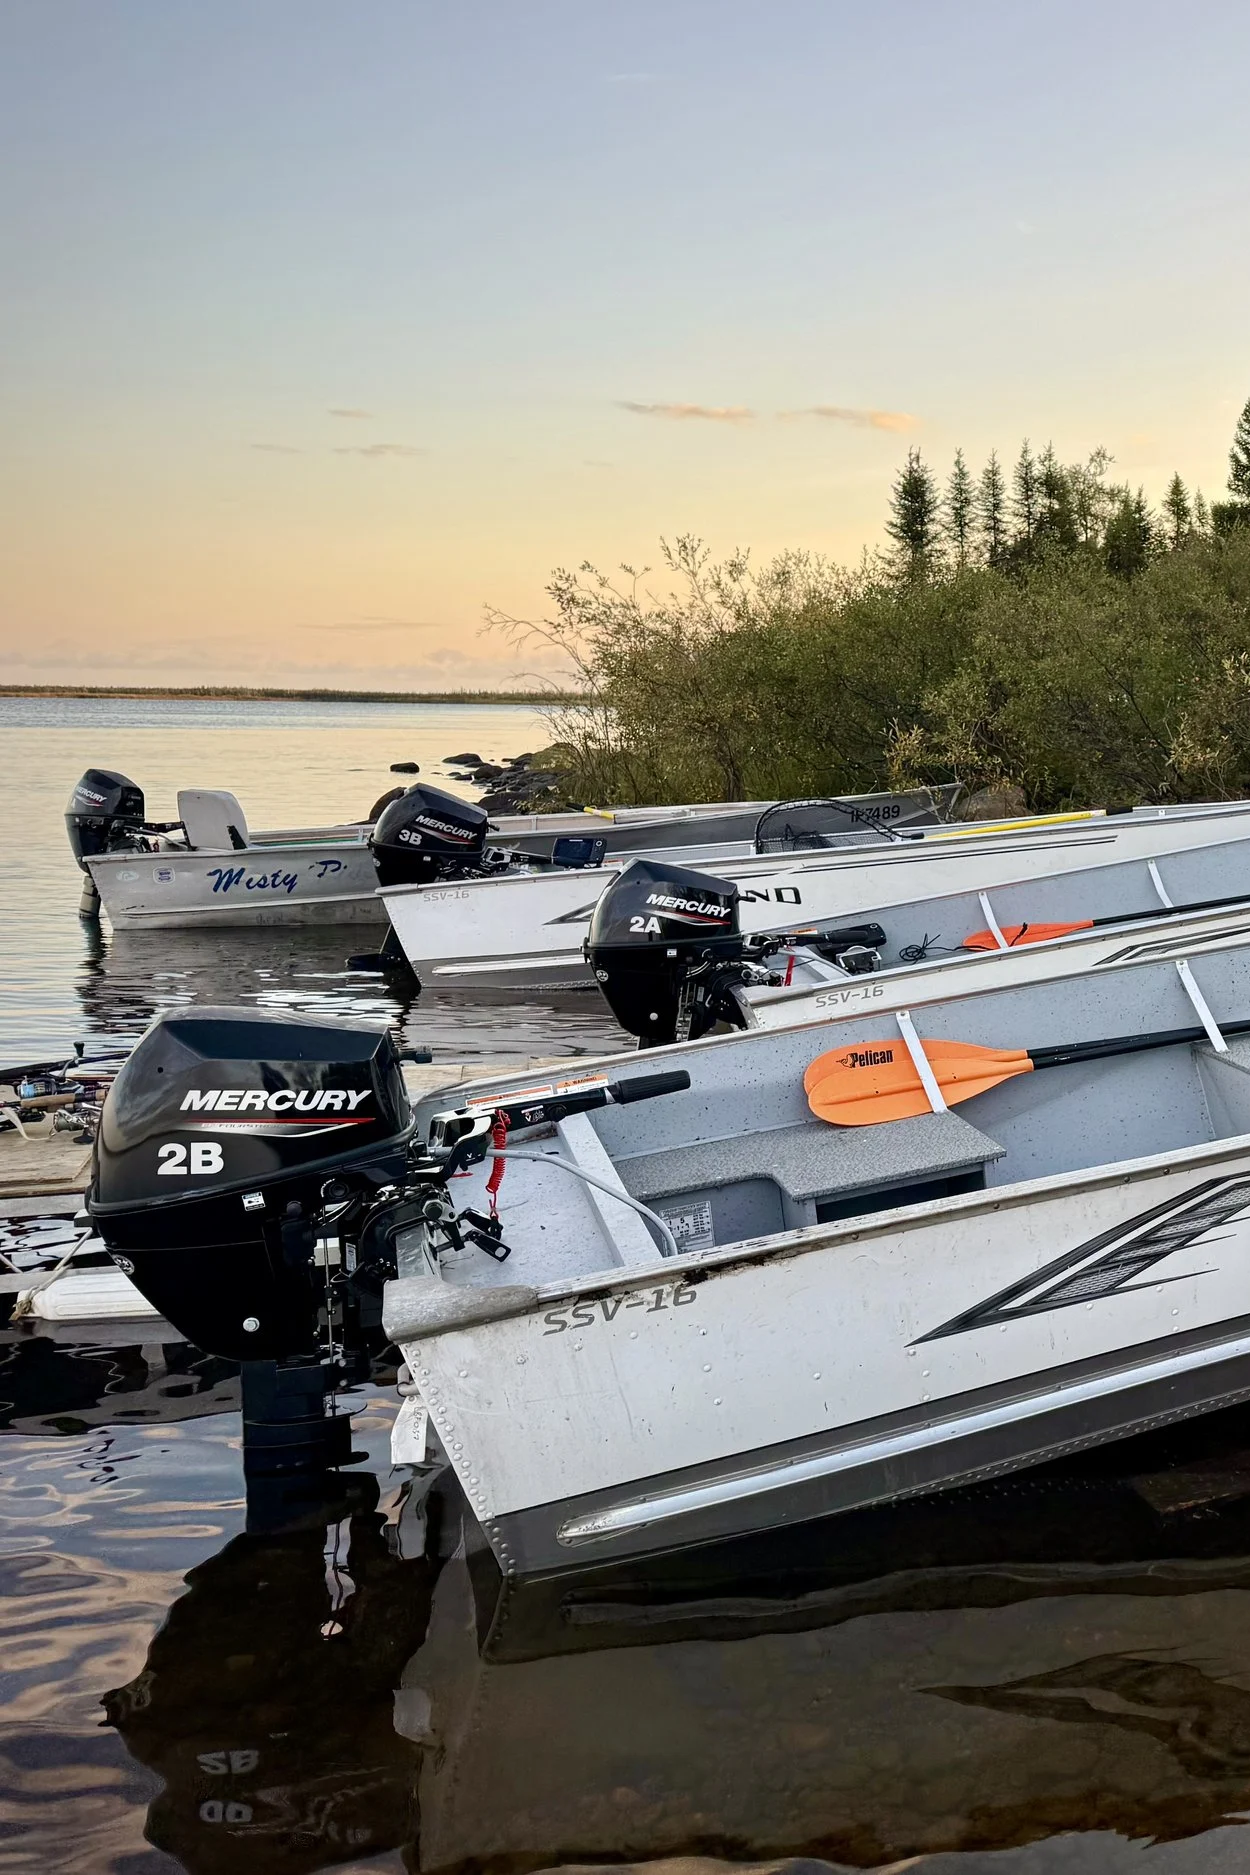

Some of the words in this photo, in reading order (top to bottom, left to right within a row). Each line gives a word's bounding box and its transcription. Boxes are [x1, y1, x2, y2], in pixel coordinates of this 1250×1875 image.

[399, 829, 423, 845] 3B
[415, 815, 477, 840] MERCURY
[206, 867, 298, 893] Misty
[424, 890, 469, 902] SSV-16
[646, 894, 731, 918] MERCURY
[745, 886, 802, 904] ND
[629, 916, 661, 934] 2A
[816, 985, 884, 1008] SSV-16
[852, 1050, 894, 1068] Pelican
[179, 1089, 372, 1111] MERCURY
[157, 1142, 224, 1175] 2B
[543, 1285, 697, 1336] SSV-16
